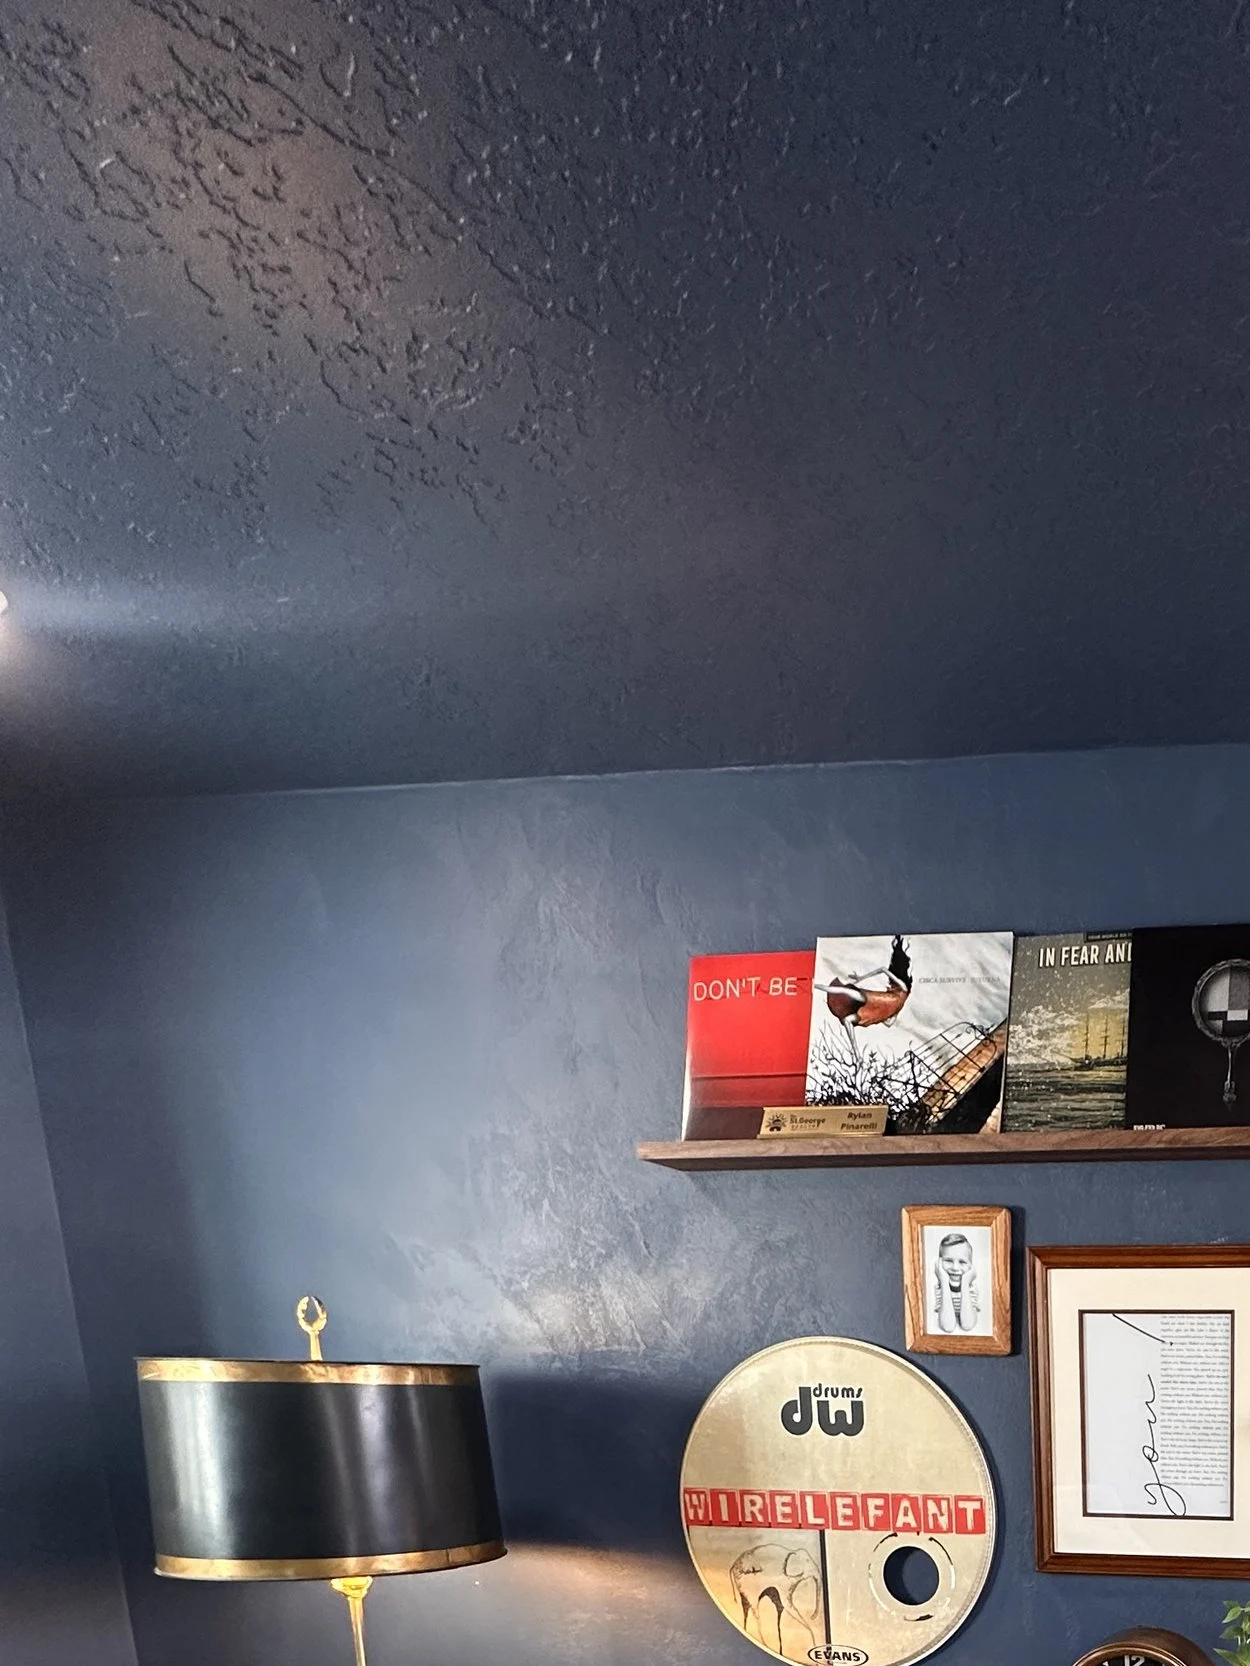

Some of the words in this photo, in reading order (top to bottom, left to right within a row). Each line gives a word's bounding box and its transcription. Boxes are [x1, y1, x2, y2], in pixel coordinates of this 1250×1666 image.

[1039, 947, 1056, 968] IN
[1061, 944, 1099, 967] FEAR
[693, 976, 761, 1001] DON'T
[769, 977, 797, 996] BE
[812, 1383, 863, 1398] drums
[781, 1387, 865, 1437] dw
[685, 1490, 982, 1532] WIRELEFANT
[814, 1650, 861, 1662] EVANS
